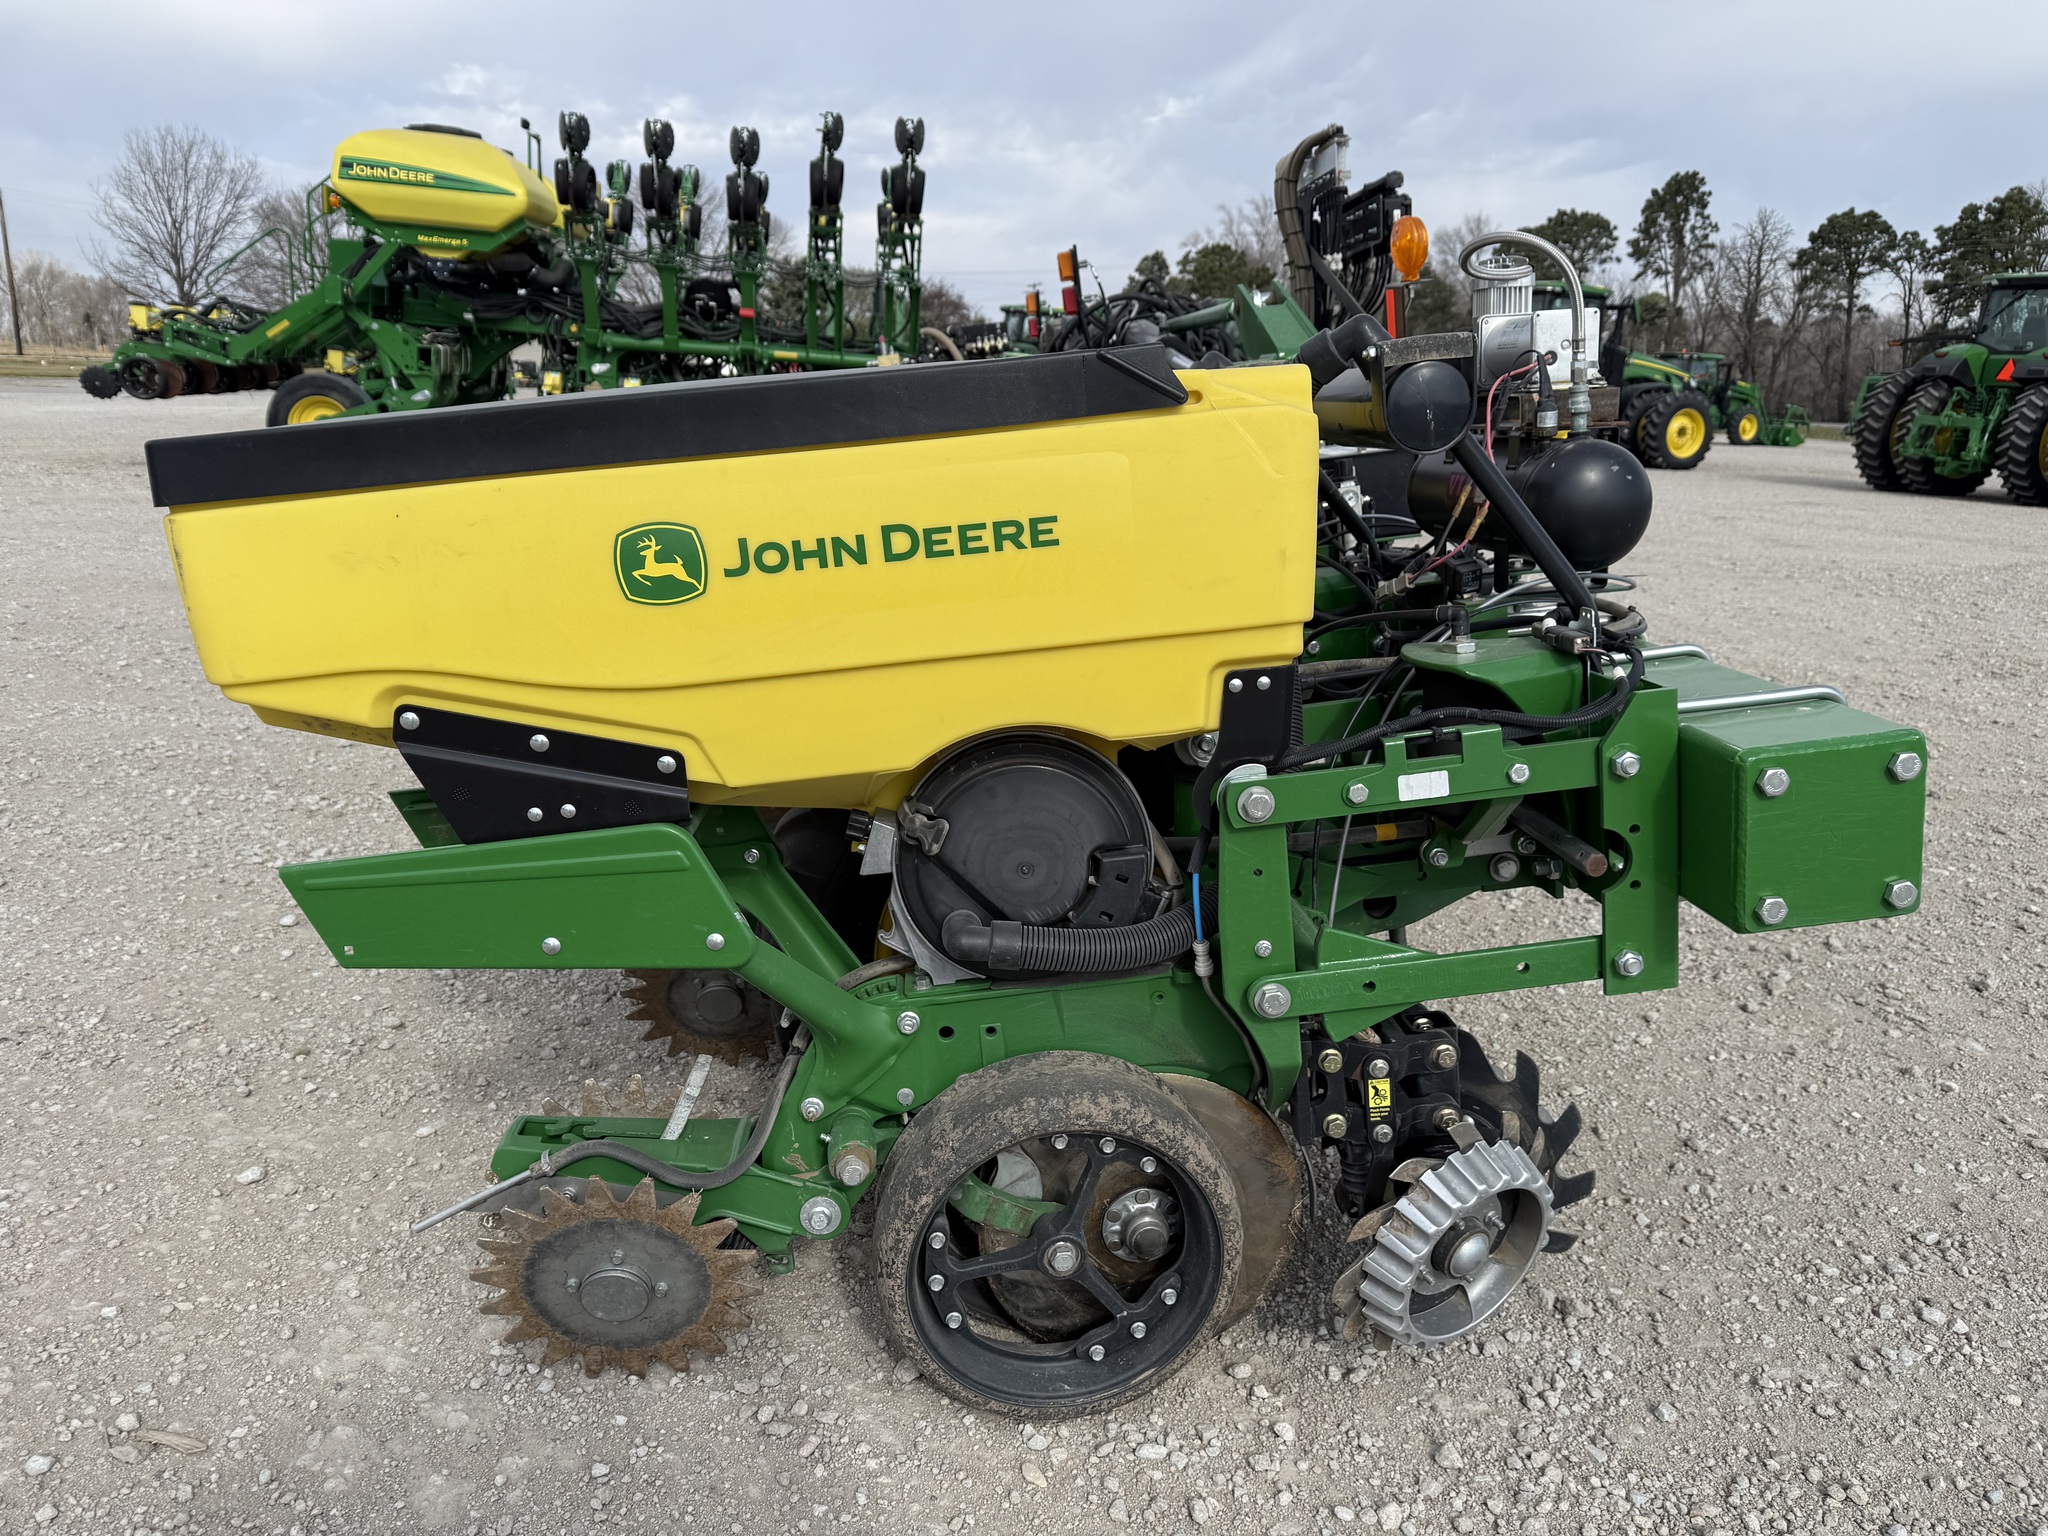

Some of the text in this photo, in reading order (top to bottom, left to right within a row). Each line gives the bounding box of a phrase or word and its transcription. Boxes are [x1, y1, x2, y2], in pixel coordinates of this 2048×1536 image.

[348, 162, 435, 184] JOHN DEERE
[417, 234, 461, 246] MaxEmerge
[723, 515, 1060, 577] JOHN DEERE
